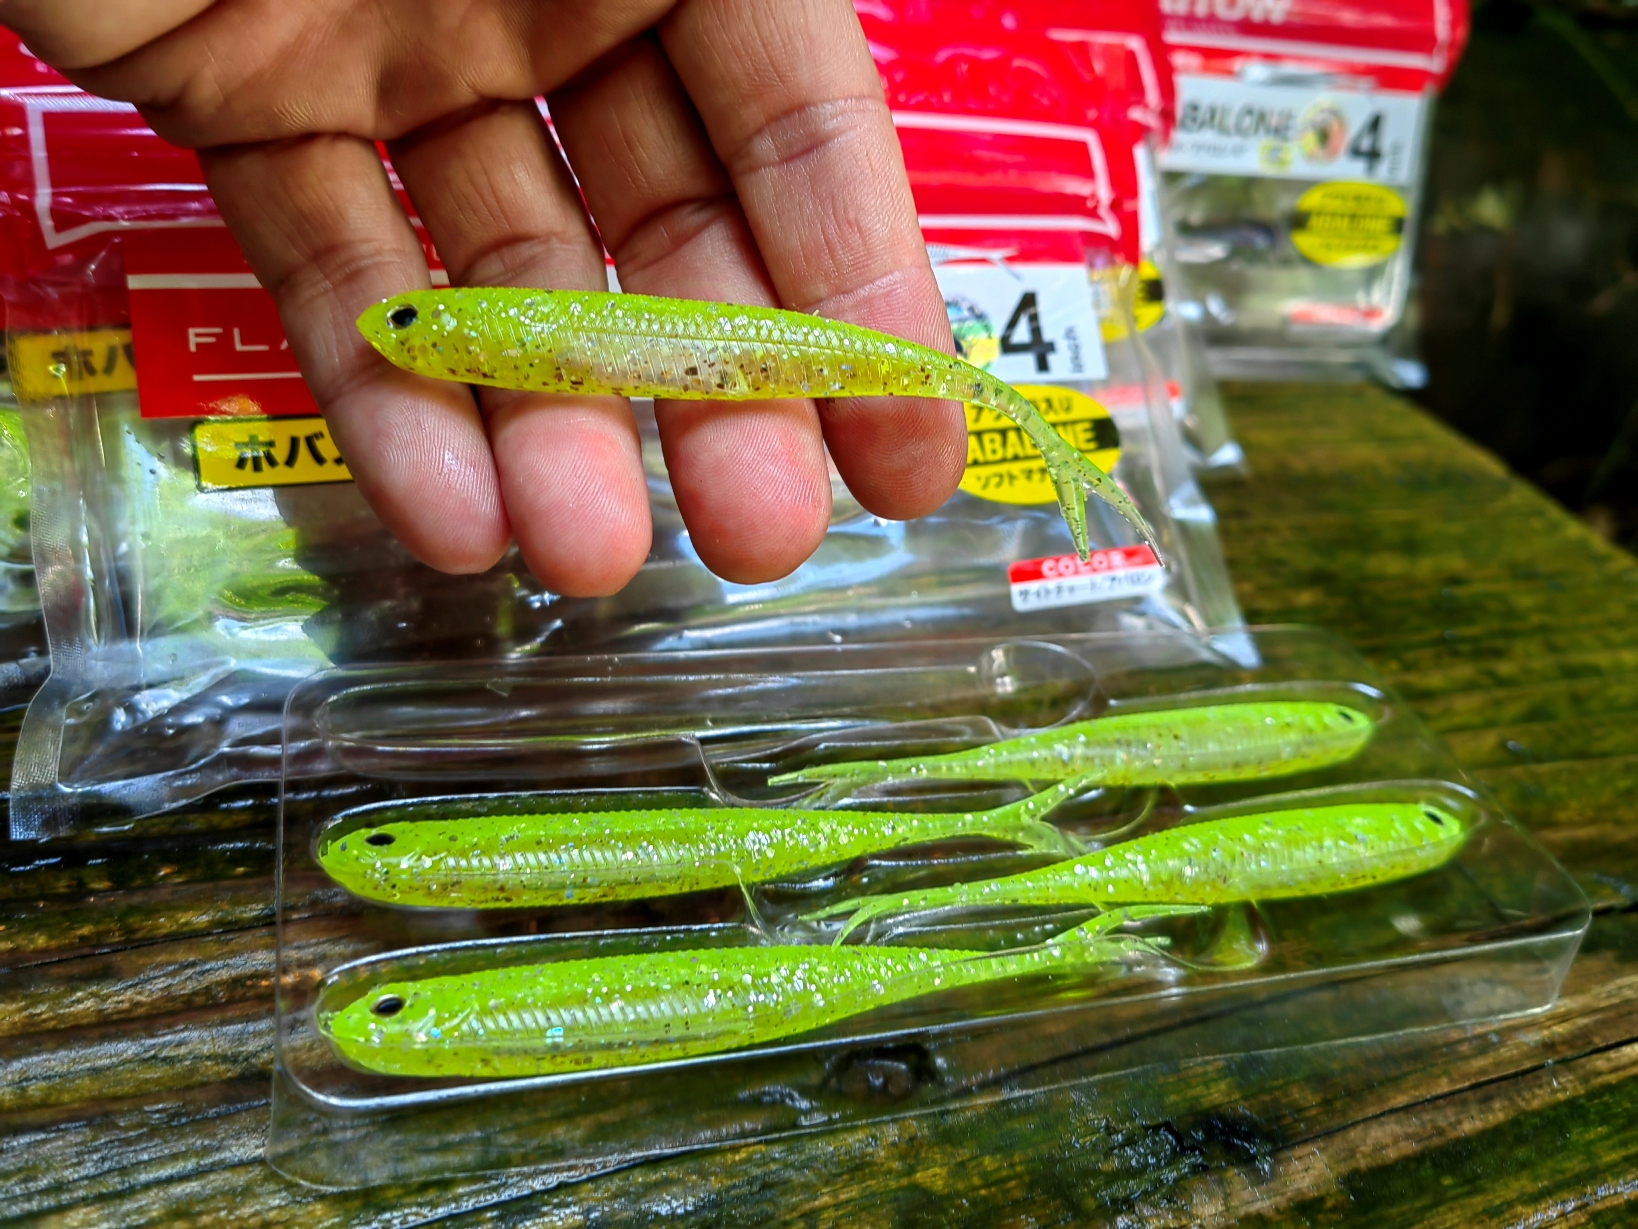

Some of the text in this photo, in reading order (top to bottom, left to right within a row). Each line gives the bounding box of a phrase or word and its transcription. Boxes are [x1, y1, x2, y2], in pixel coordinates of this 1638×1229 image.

[1348, 110, 1385, 177] 4
[188, 327, 289, 352] FL
[1000, 291, 1056, 373] 4
[233, 431, 344, 473] ホバ
[967, 421, 1098, 465] ABALNE
